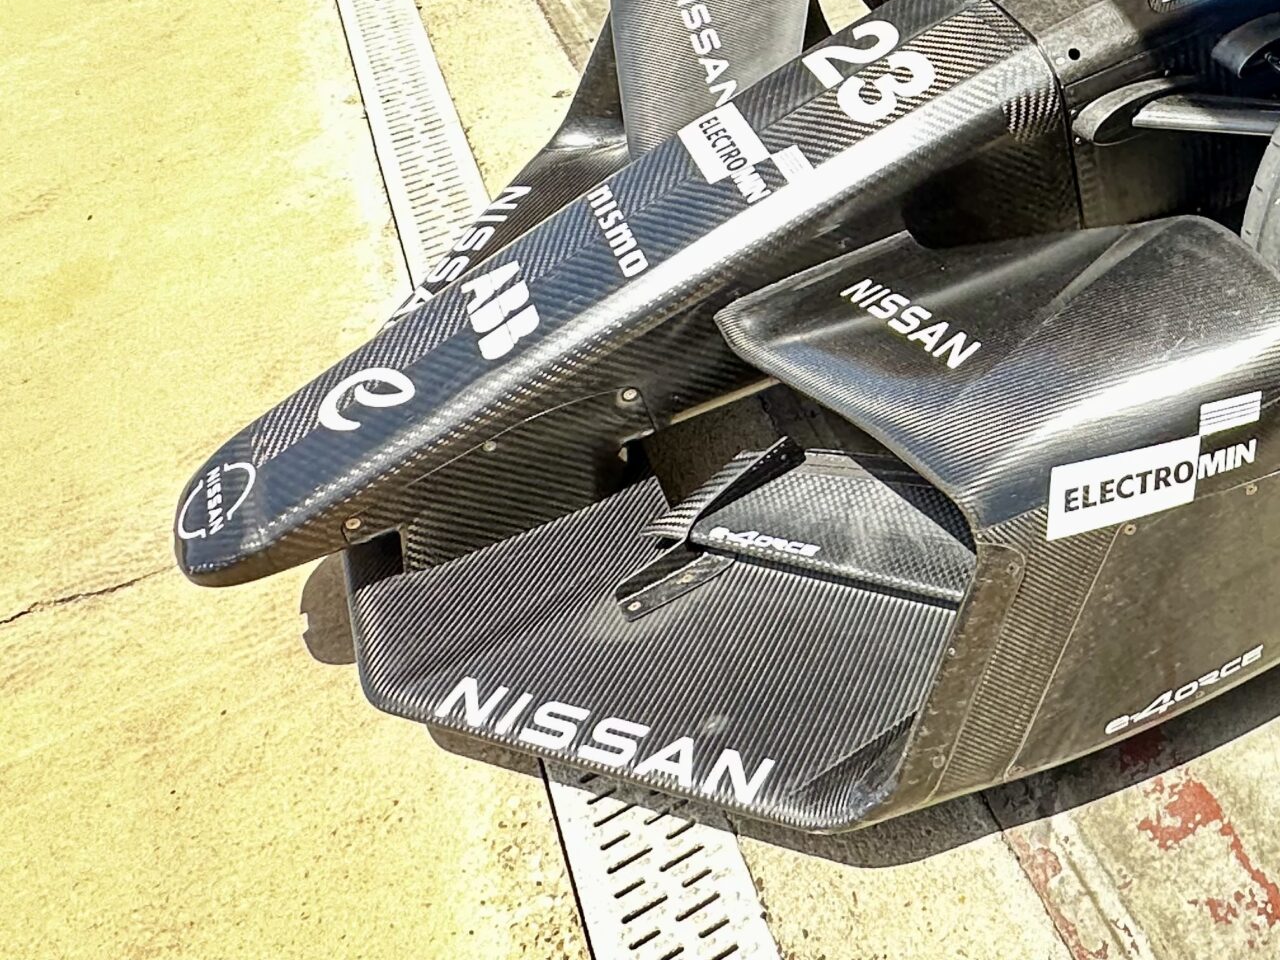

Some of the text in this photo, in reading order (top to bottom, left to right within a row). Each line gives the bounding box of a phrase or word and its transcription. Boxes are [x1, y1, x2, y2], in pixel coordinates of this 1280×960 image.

[802, 19, 936, 125] 23
[697, 115, 772, 204] ELECTROMIN
[383, 186, 532, 329] NISSA
[461, 260, 540, 360] ABB
[840, 278, 982, 370] NISSAN
[206, 466, 225, 535] NISSAN
[1063, 438, 1256, 512] ELECTROMIN
[434, 676, 776, 805] NISSAN
